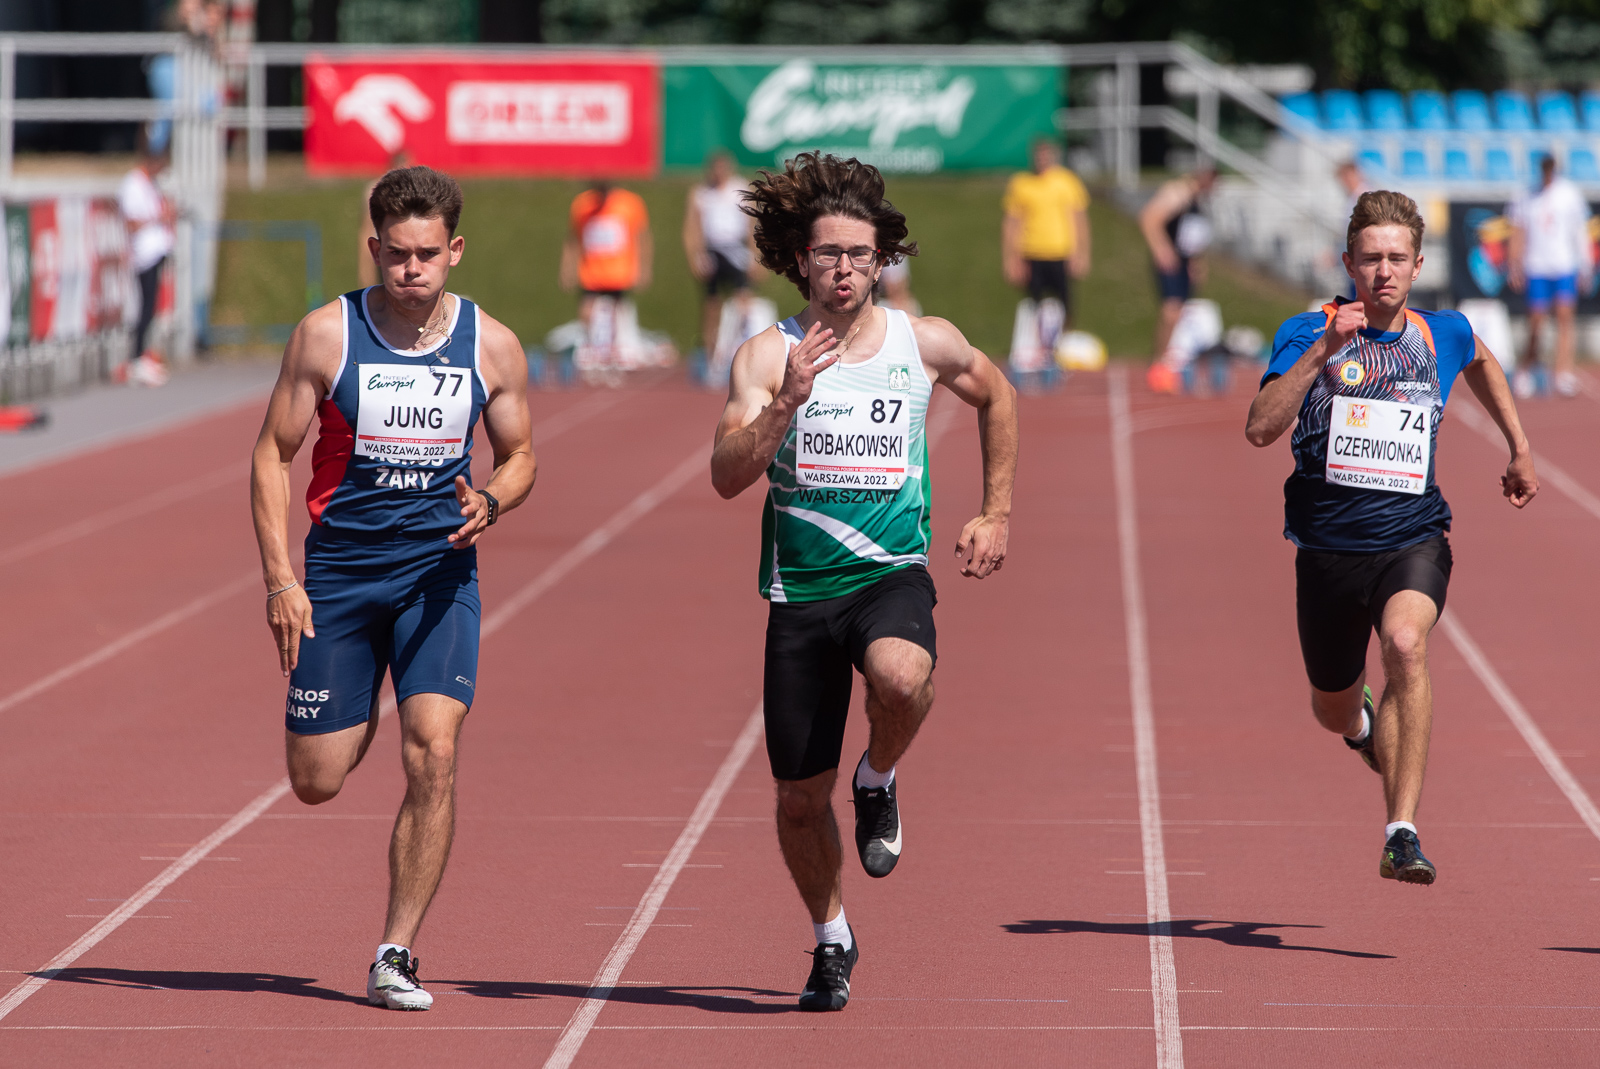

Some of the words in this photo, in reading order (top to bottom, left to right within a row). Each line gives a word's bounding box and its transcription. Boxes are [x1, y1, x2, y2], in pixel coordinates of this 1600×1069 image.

[367, 373, 416, 392] Europol
[432, 372, 464, 397] 77
[1395, 380, 1432, 391] DECATHLON
[383, 405, 443, 430] JUNG
[804, 400, 854, 420] Europol
[870, 398, 903, 424] 87
[1399, 409, 1425, 434] 74
[364, 442, 420, 456] WARSZAWA
[423, 446, 445, 456] 2022
[803, 432, 903, 458] ROBAKOWSKI
[1334, 435, 1422, 465] CZERWIONKA
[374, 465, 435, 491] ŻARY
[804, 472, 861, 485] WARSZAWA
[863, 475, 888, 485] 2022
[1333, 472, 1385, 486] WARSZAWA
[1388, 478, 1410, 489] 2022
